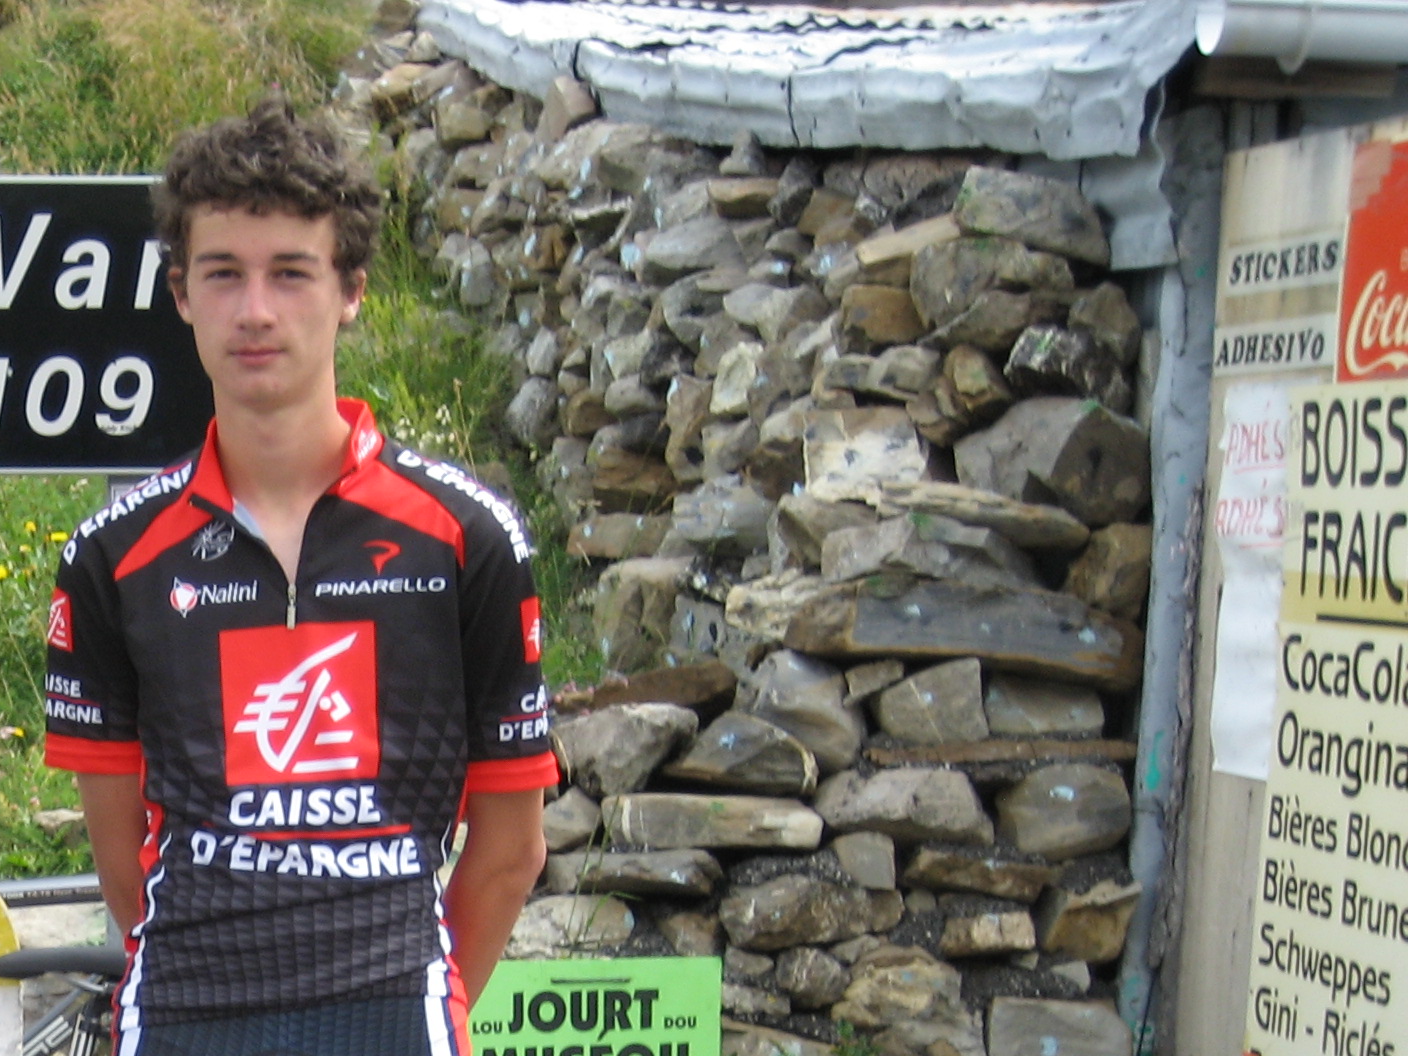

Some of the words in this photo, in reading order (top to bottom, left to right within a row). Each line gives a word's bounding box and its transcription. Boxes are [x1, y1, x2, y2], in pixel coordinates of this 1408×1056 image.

[1229, 239, 1340, 286] STICKERS
[1214, 327, 1326, 368] ADHESIVO
[200, 580, 257, 606] Nalini
[315, 577, 447, 597] PINARELLO
[229, 785, 381, 827] CAISSE
[1268, 794, 1338, 853] Bières
[192, 832, 421, 879] D'EPARGNE
[1262, 858, 1333, 919] Bières
[1258, 922, 1391, 1017] Schweppes
[472, 1021, 503, 1035] LOU
[508, 988, 660, 1034] JOURT
[664, 1015, 697, 1029] DOU
[1255, 986, 1298, 1042] Gini
